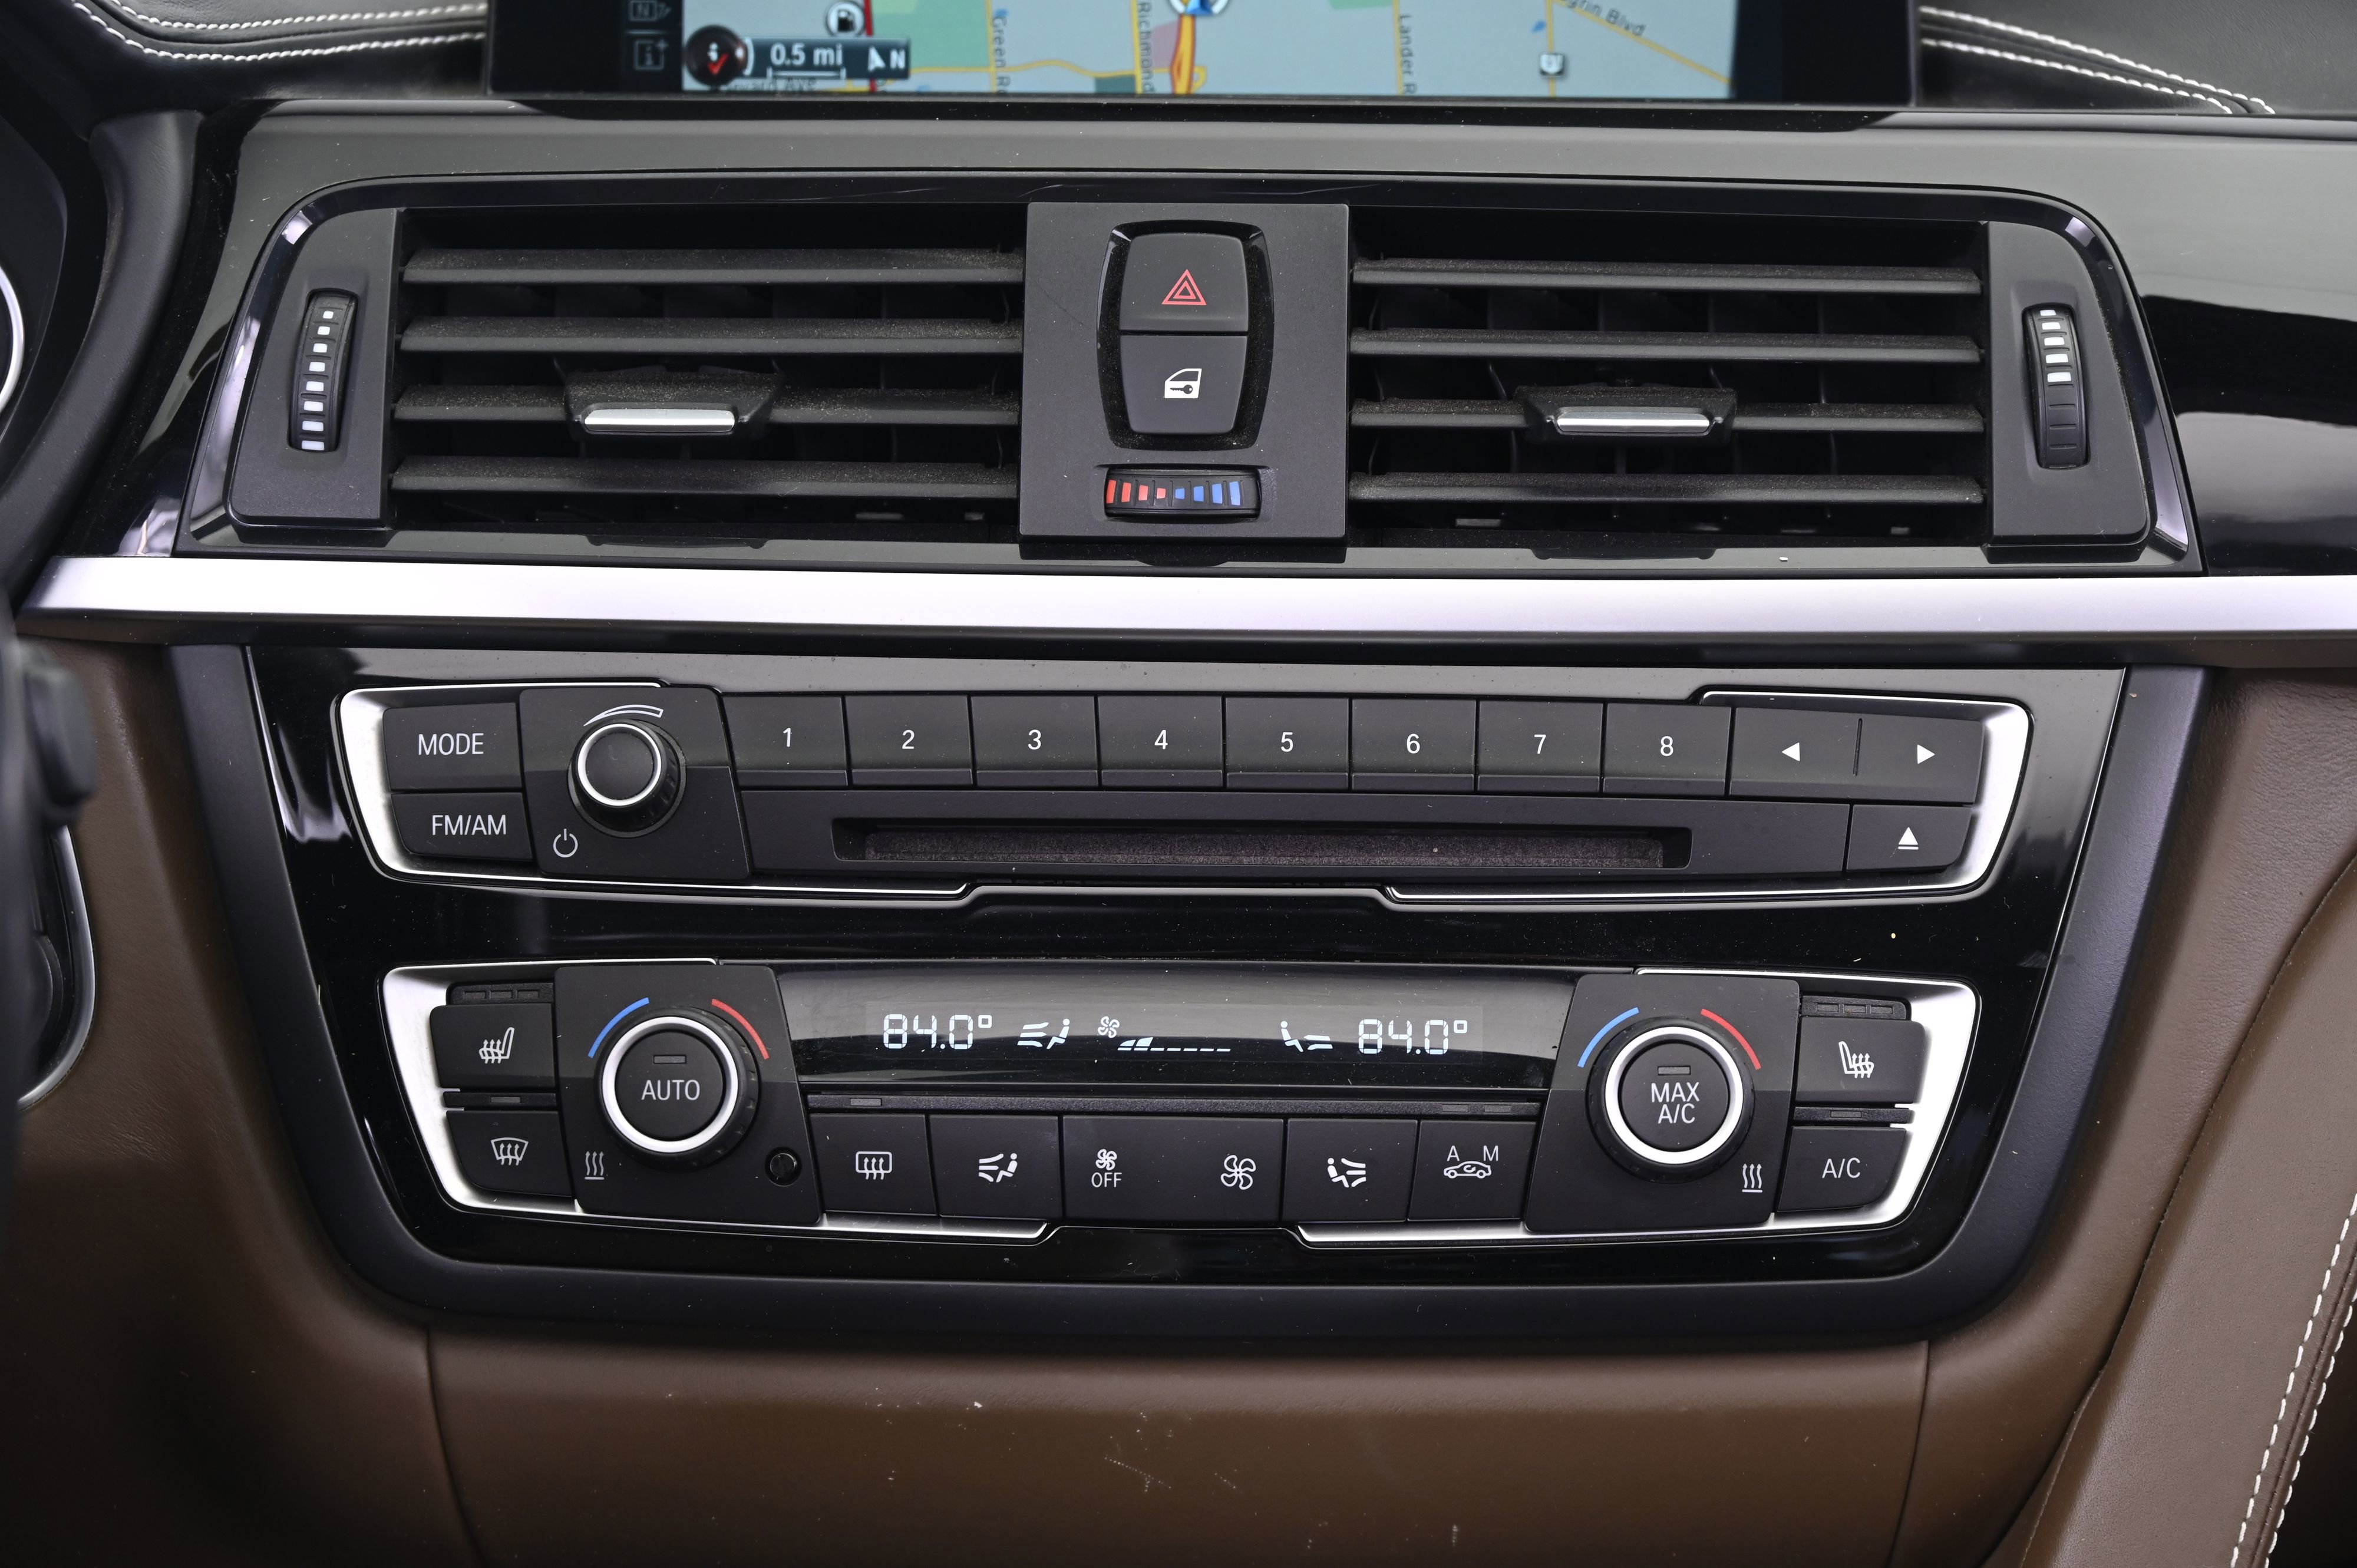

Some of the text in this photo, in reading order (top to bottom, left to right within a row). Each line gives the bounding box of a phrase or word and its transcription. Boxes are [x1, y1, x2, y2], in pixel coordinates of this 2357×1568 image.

[1605, 9, 1646, 37] Blvd
[993, 16, 1007, 68] Green
[1138, 2, 1155, 93] Richmond
[1399, 15, 1414, 75] Lander
[770, 42, 843, 65] 0.5 mi
[890, 49, 906, 69] N
[418, 733, 484, 755] MODE
[783, 728, 792, 747] 1
[902, 730, 915, 750] 2
[1028, 729, 1041, 750] 3
[1154, 730, 1168, 749] 4
[1280, 732, 1293, 752] 5
[1407, 734, 1420, 753] 6
[1534, 735, 1546, 754] 7
[1660, 736, 1673, 756] 8
[432, 815, 506, 836] FM/AM
[641, 1080, 700, 1101] AUTO
[1651, 1082, 1699, 1102] MAX
[1658, 1104, 1695, 1124] A/C
[1447, 1146, 1499, 1161] A M
[1822, 1158, 1860, 1179] A/C
[1091, 1173, 1122, 1188] OFF
